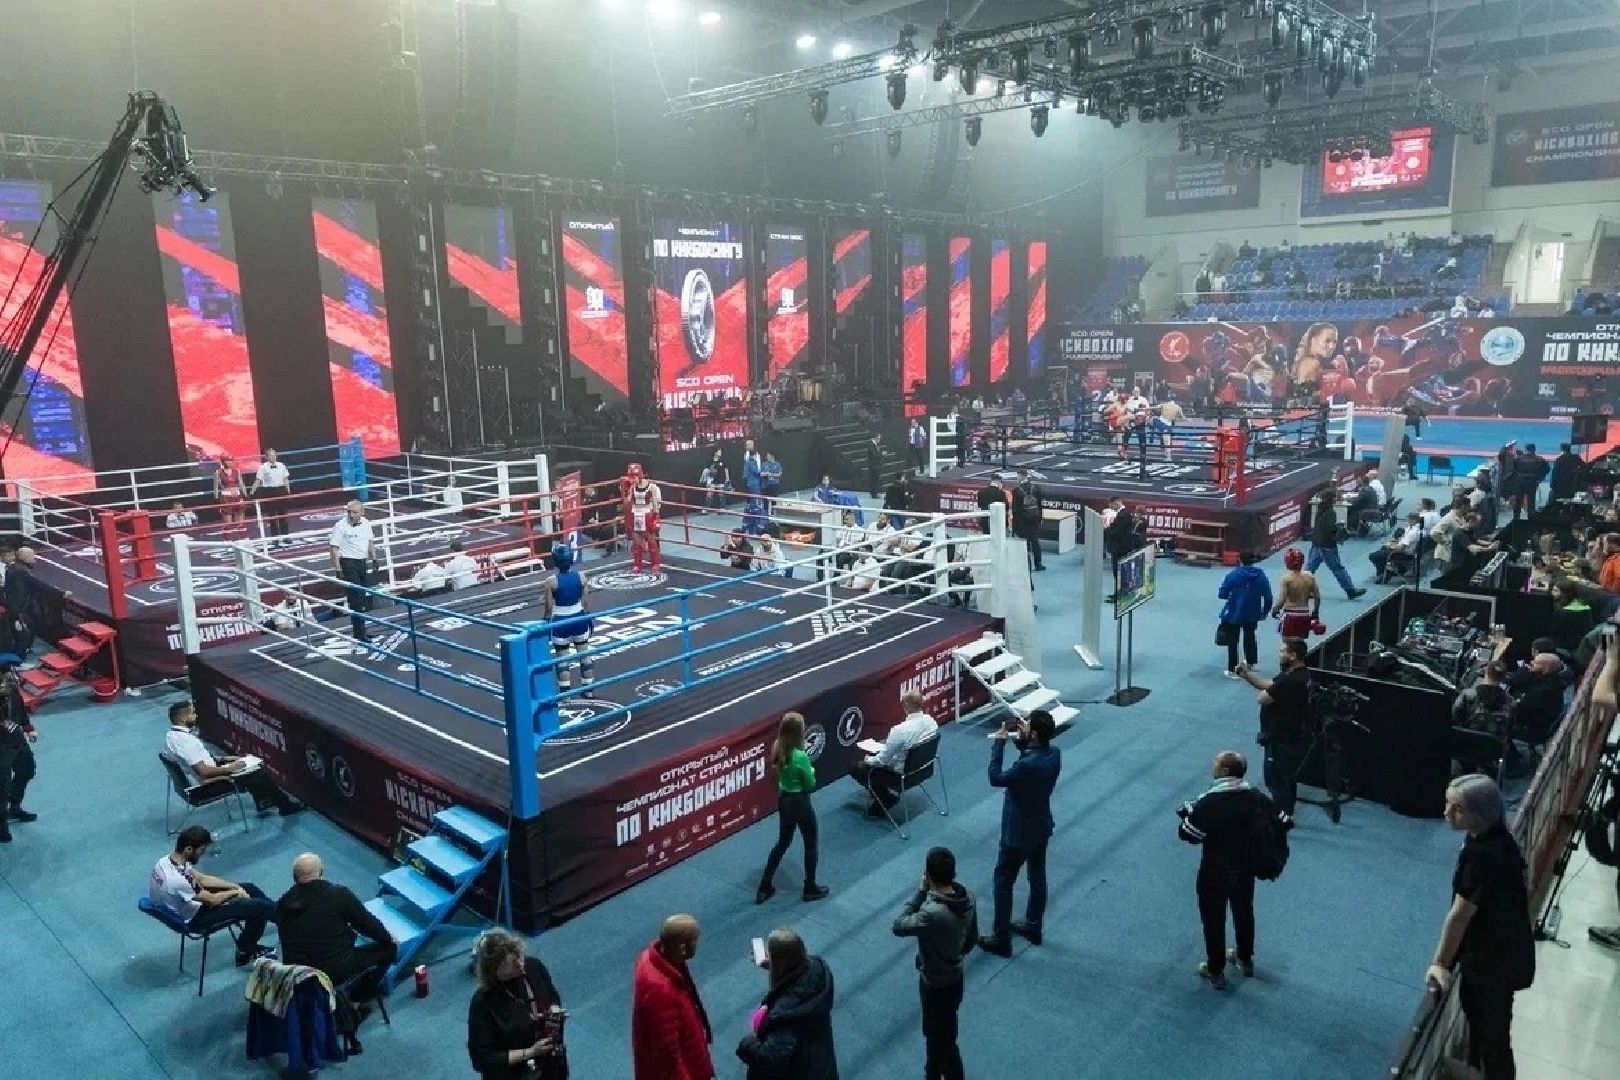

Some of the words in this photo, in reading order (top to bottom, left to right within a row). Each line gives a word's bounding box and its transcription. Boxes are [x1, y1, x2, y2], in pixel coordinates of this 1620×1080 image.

[1575, 120, 1615, 132] OPEN
[1534, 131, 1619, 150] KICKBOXING
[653, 239, 668, 257] ПО
[1060, 338, 1134, 353] ICKBOXING
[1543, 343, 1570, 361] ПО
[1577, 342, 1620, 361] КИК
[676, 378, 701, 387] SCO
[704, 374, 734, 384] OPEN
[660, 745, 729, 783] ОТКРЫТЫЙ
[616, 773, 697, 813] ЧЕМПИОНАТ
[699, 755, 739, 781] СТРАН
[741, 743, 765, 761] ШОС
[616, 811, 642, 847] ПО
[648, 756, 766, 832] КИКБОКСИНГУ
